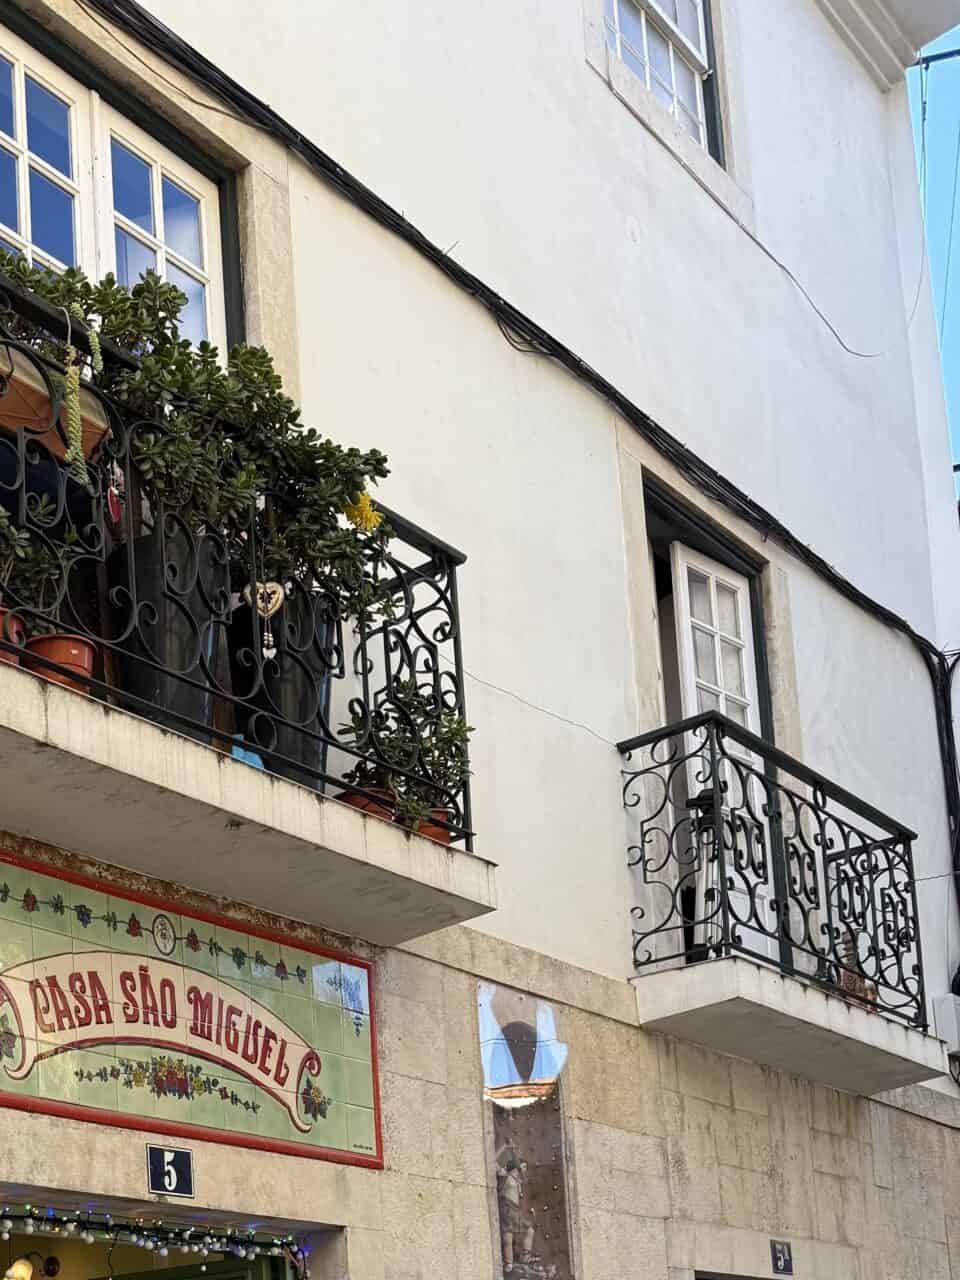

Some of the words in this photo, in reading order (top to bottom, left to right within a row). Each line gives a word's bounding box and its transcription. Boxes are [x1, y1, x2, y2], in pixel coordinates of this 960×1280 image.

[29, 970, 113, 1034] CASA
[119, 964, 177, 1030] SÃO
[187, 985, 290, 1087] MIGUEL
[161, 1152, 178, 1191] 5
